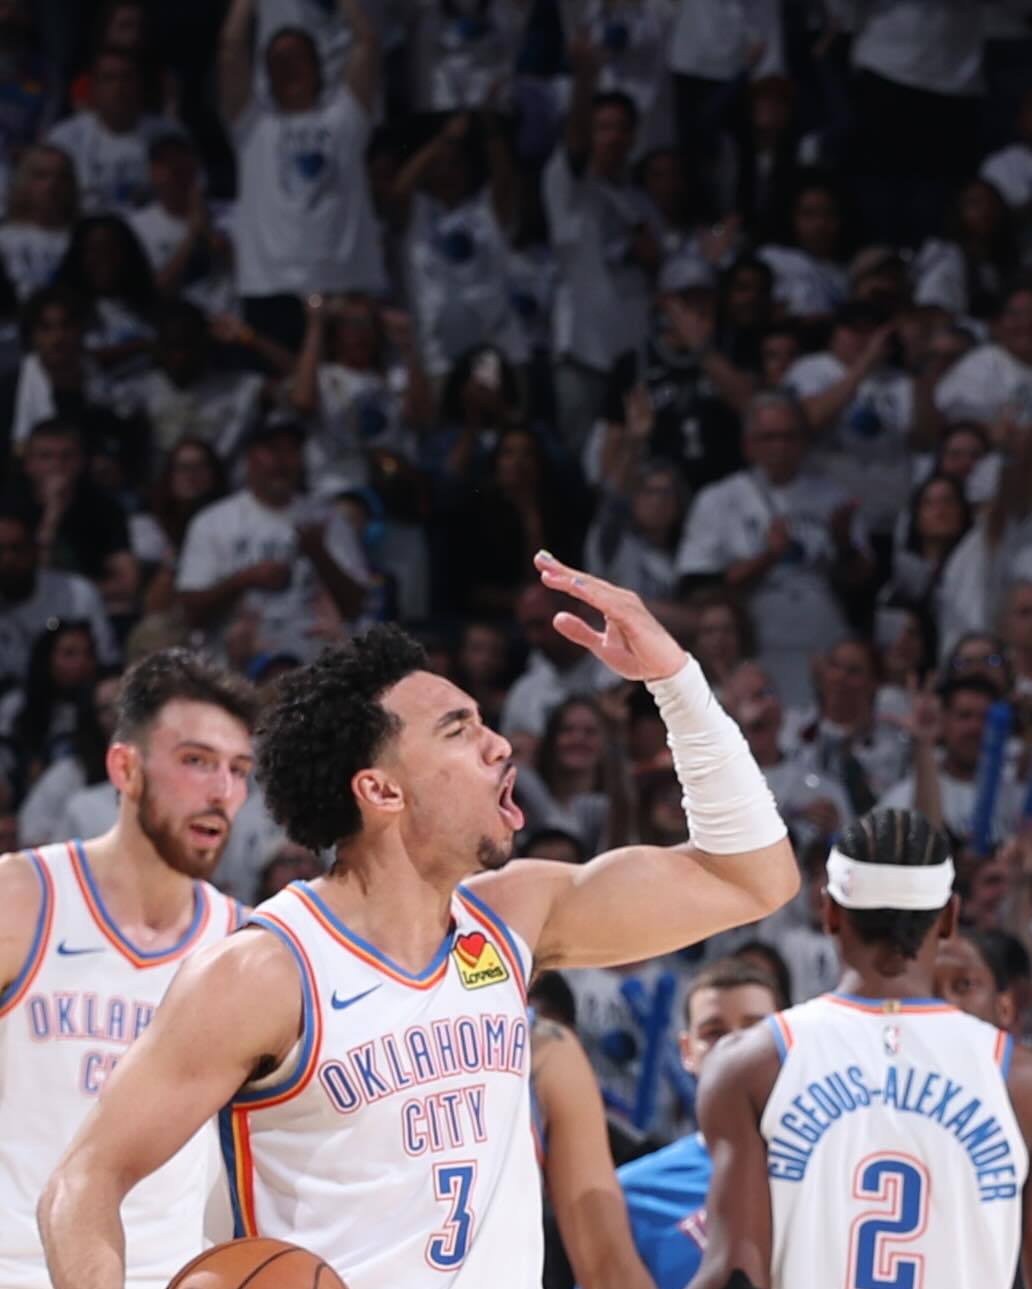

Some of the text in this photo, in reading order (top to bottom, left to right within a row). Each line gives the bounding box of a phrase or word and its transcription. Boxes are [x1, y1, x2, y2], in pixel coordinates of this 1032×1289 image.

[25, 991, 155, 1045] OKLAH
[318, 1013, 528, 1115] OKLAHOMA
[401, 1083, 488, 1158] CITY
[767, 1066, 1018, 1205] GILGEOUS-ALEXANDER
[424, 1159, 478, 1272] 3
